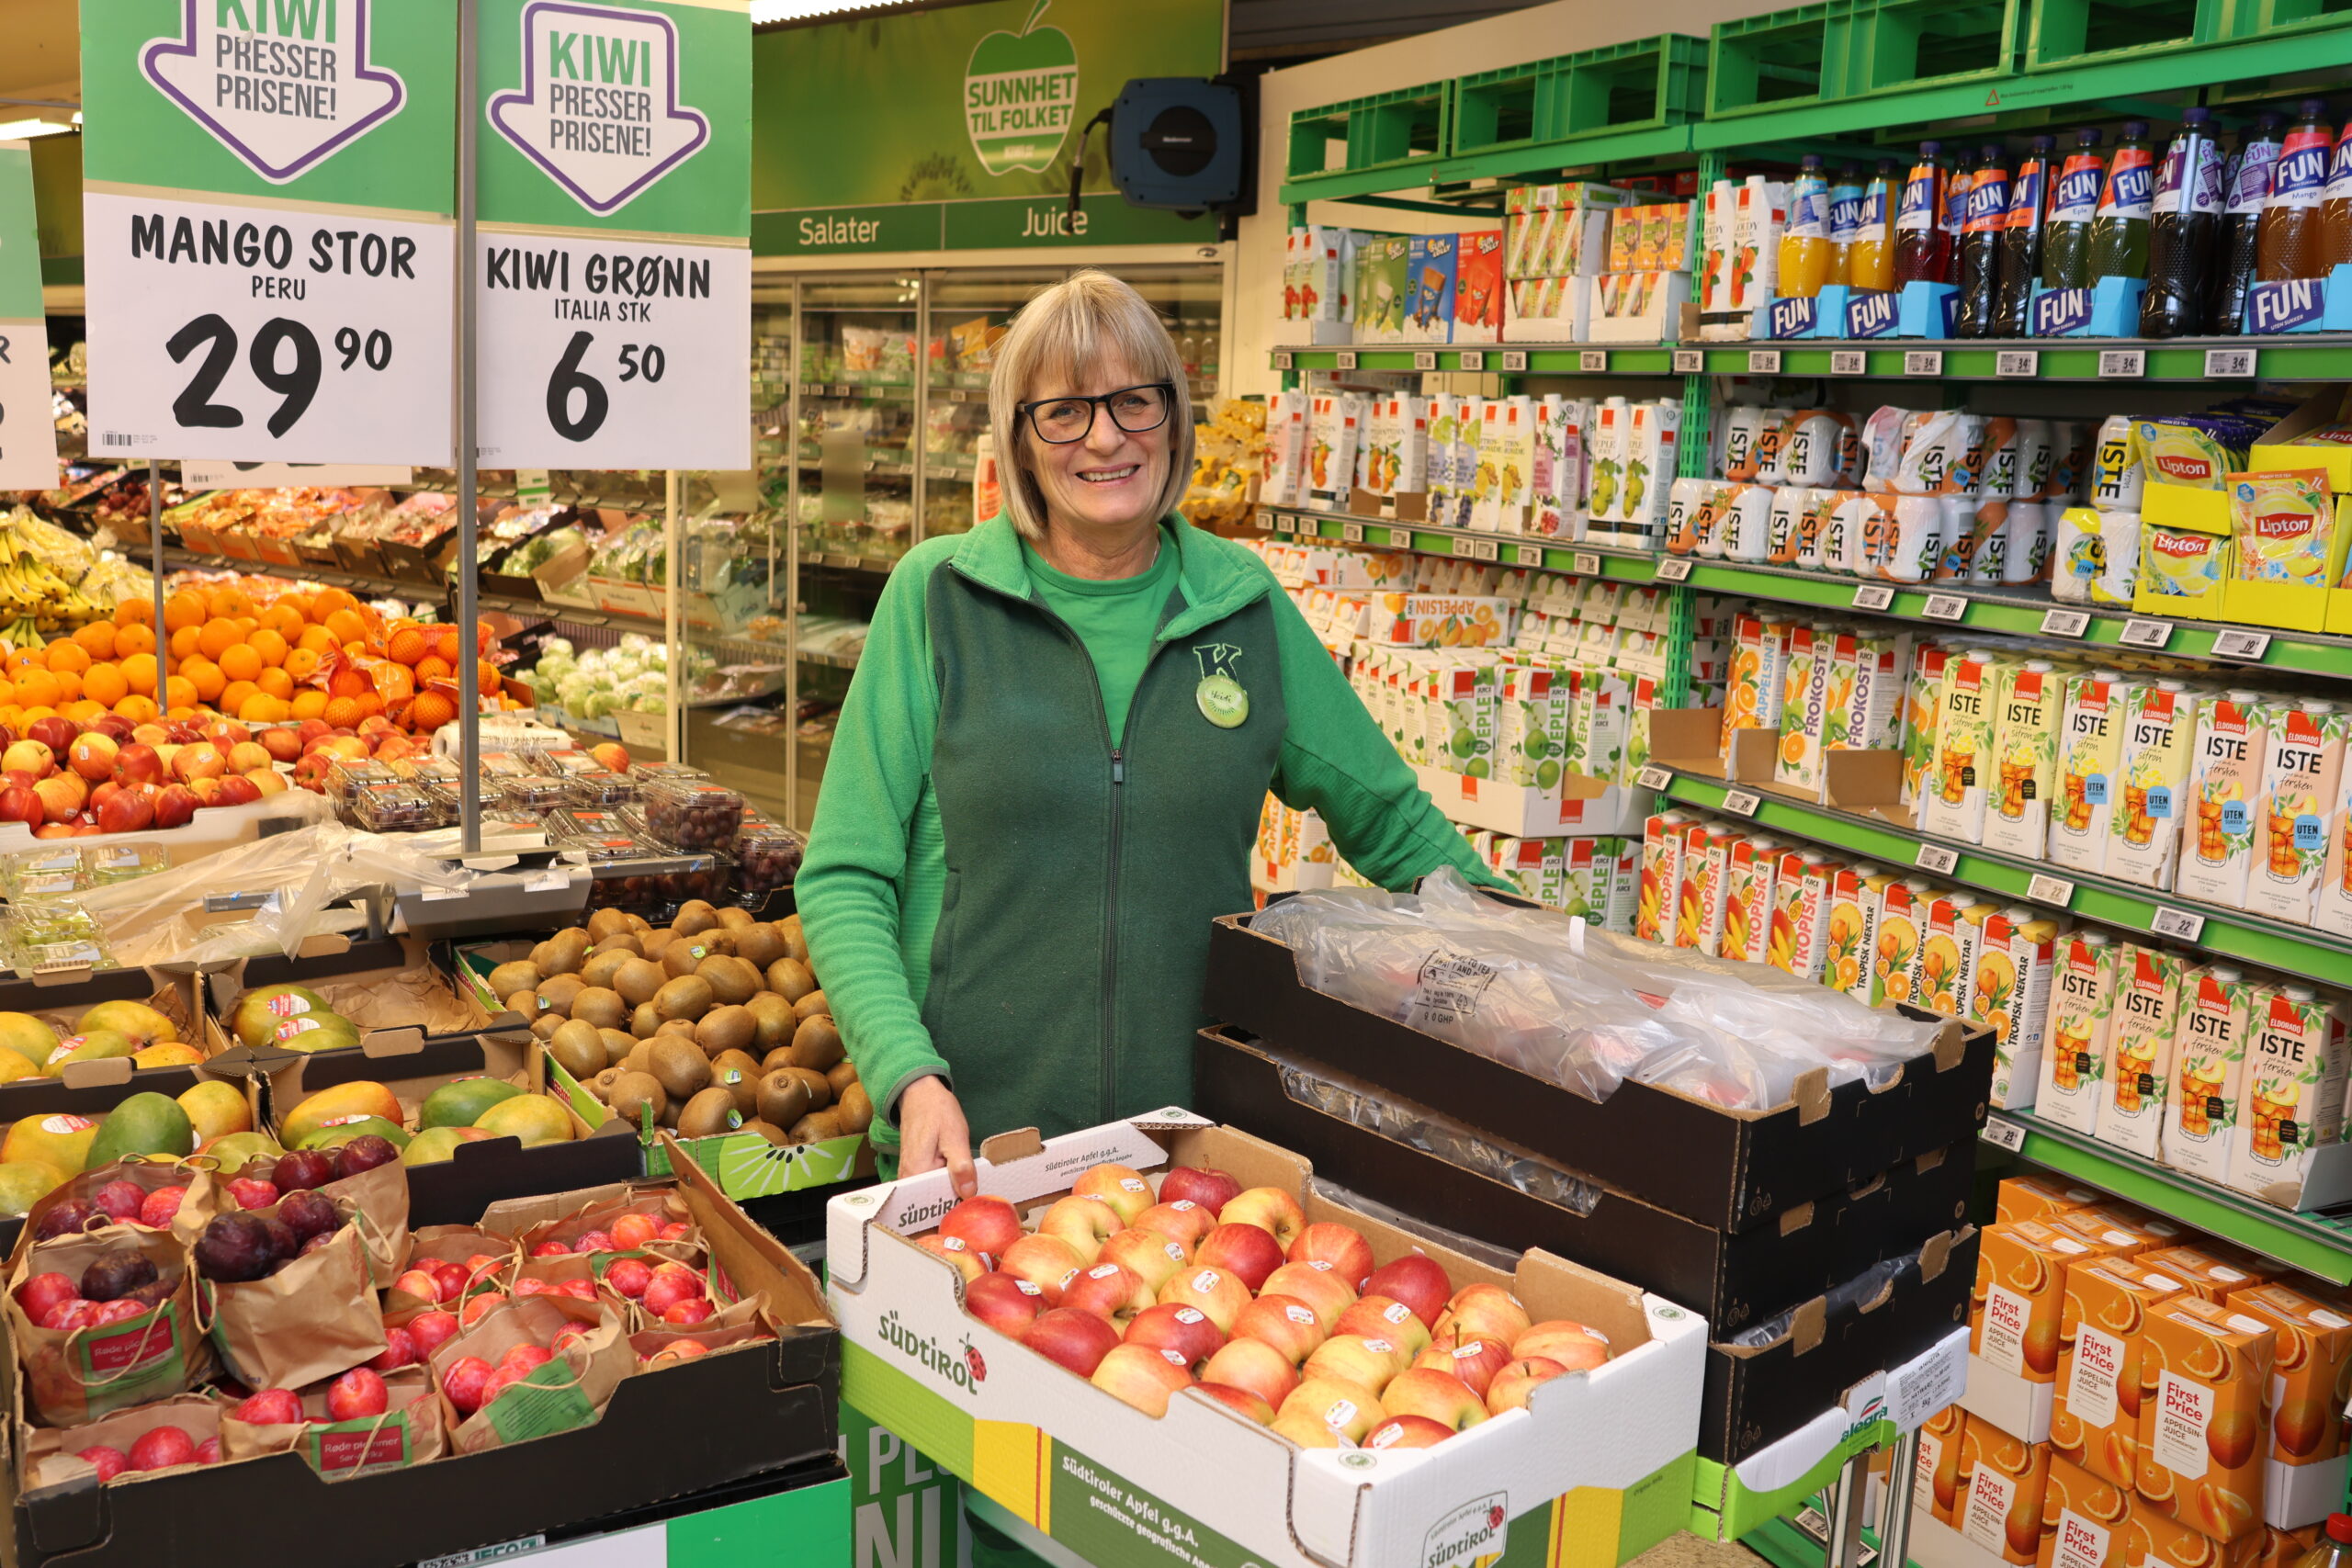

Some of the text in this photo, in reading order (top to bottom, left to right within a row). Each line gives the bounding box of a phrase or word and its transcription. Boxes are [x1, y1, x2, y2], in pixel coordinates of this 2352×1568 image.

[215, 33, 336, 83] PRESSER
[549, 30, 651, 87] KIWI
[216, 73, 336, 120] PRISENE!
[550, 84, 651, 122] PRESSER
[967, 73, 1077, 108] SUNNHET
[970, 105, 1071, 133] TIL FOLKET
[550, 119, 651, 158] PRISENE!
[2245, 145, 2272, 164] FUN
[2278, 152, 2324, 188] FUN
[2058, 174, 2097, 204] FUN
[2117, 170, 2153, 199] FUN
[2291, 191, 2317, 200] Mango
[1968, 186, 2003, 217] FUN
[798, 217, 880, 245] Salater
[1023, 207, 1088, 237] Juice
[130, 214, 417, 279] MANGO STOR
[485, 246, 711, 299] KIWI GRØNN
[251, 275, 307, 300] PERU
[553, 298, 651, 323] ITALIA STK
[1774, 298, 1810, 334] FUN
[1851, 293, 1891, 334] FUN
[2041, 288, 2084, 331] FUN
[2256, 278, 2312, 329] FUN
[165, 312, 392, 439] 29 90
[2233, 356, 2245, 369] 34
[546, 331, 665, 442] 6 50
[1728, 427, 1748, 470] ISTE
[2206, 428, 2217, 441] 1L
[1758, 428, 1779, 472] ISTE
[1792, 431, 1810, 475] ISTE
[1925, 446, 1945, 491] ISTE
[1963, 446, 1982, 493] ISTE
[1997, 448, 2016, 494] ISTE
[2032, 445, 2051, 493] ISTE
[2098, 441, 2127, 499] ISTE
[2161, 458, 2205, 476] Lipton
[2312, 477, 2324, 491] 1L
[1668, 501, 1684, 544] ISTE
[1698, 502, 1713, 545] ISTE
[1728, 506, 1742, 550] ISTE
[1770, 510, 1789, 555] ISTE
[1799, 512, 1816, 557] ISTE
[2260, 519, 2309, 536] Lipton
[1827, 515, 1844, 562] ISTE
[2156, 533, 2205, 551] Lipton
[1921, 533, 1940, 580] ISTE
[1954, 535, 1973, 578] ISTE
[1988, 534, 2006, 579] ISTE
[2031, 530, 2047, 576] ISTE
[1416, 600, 1476, 615] APPELSIN
[2151, 627, 2160, 639] 19
[2245, 639, 2256, 651] 19
[1756, 647, 1775, 716] APPELSIN
[1956, 680, 1979, 691] ELDORADO
[2015, 690, 2039, 701] ELDORADO
[1804, 656, 1826, 737] FROKOST
[1849, 663, 1871, 747] FROKOST
[1949, 694, 1982, 716] ISTE
[2080, 699, 2106, 711] ELDORADO
[1476, 697, 1492, 737] EPLE
[1550, 699, 1566, 740] EPLE
[1577, 701, 1591, 743] EPLE
[2007, 704, 2042, 726] ISTE
[2073, 714, 2109, 737] ISTE
[2143, 709, 2171, 721] ELDORADO
[2216, 722, 2245, 734] ELDORADO
[2133, 724, 2174, 749] ISTE
[2206, 737, 2248, 761] ISTE
[2288, 733, 2319, 745] ELDORADO
[2277, 748, 2324, 774] ISTE
[2087, 783, 2105, 792] UTEN
[2149, 795, 2169, 805] UTEN
[2223, 810, 2244, 819] UTEN
[2297, 825, 2319, 835] UTEN
[1938, 855, 1947, 865] 23
[1590, 868, 1608, 909] EPLE
[1658, 849, 1676, 921] TROPISK
[1699, 860, 1720, 935] TROPISK
[1745, 874, 1768, 953] TROPISK
[1887, 903, 1910, 916] ELDORADO
[1792, 889, 1817, 969] TROPISK
[1930, 919, 1953, 933] ELDORADO
[2177, 918, 2190, 931] 22
[1857, 907, 1874, 989] TROPISK NEKTAR
[1985, 936, 2009, 950] ELDORADO
[1959, 939, 1972, 978] NEKTAR
[2070, 960, 2095, 976] ELDORADO
[2007, 955, 2029, 1046] TROPISK NEKTAR
[2062, 976, 2098, 1000] ISTE
[2125, 992, 2164, 1020] ISTE
[2199, 998, 2228, 1013] ELDORADO
[2188, 1011, 2232, 1042] ISTE
[2269, 1018, 2302, 1035] ELDORADO
[2259, 1032, 2305, 1064] ISTE
[2005, 1130, 2014, 1142] 23
[1046, 1146, 1119, 1172] Südtiroler Apfel g.g.A.
[1991, 1306, 2020, 1330] Price
[1993, 1293, 2019, 1316] First
[1987, 1335, 2006, 1348] JUICE
[1988, 1326, 2019, 1346] APPELSIN-
[2083, 1334, 2112, 1358] First
[2081, 1347, 2114, 1371] Price
[2077, 1377, 2098, 1391] JUICE
[2078, 1368, 2113, 1388] APPELSIN-
[2165, 1394, 2203, 1421] Price
[2167, 1382, 2199, 1406] First
[1840, 1406, 1888, 1443] alegra
[2163, 1426, 2186, 1440] JUICE
[2164, 1416, 2203, 1438] APPELSIN-
[324, 1442, 352, 1453] Røde
[1975, 1484, 2005, 1510] Price
[1977, 1472, 2004, 1496] First
[1062, 1455, 1199, 1548] Südtiroler Apfel g.g.A.
[1972, 1504, 2003, 1526] APPELSIN-
[1090, 1495, 1192, 1562] geschützte geografische
[1970, 1512, 1988, 1527] JUICE
[2066, 1520, 2096, 1546] First
[2064, 1532, 2098, 1560] Price
